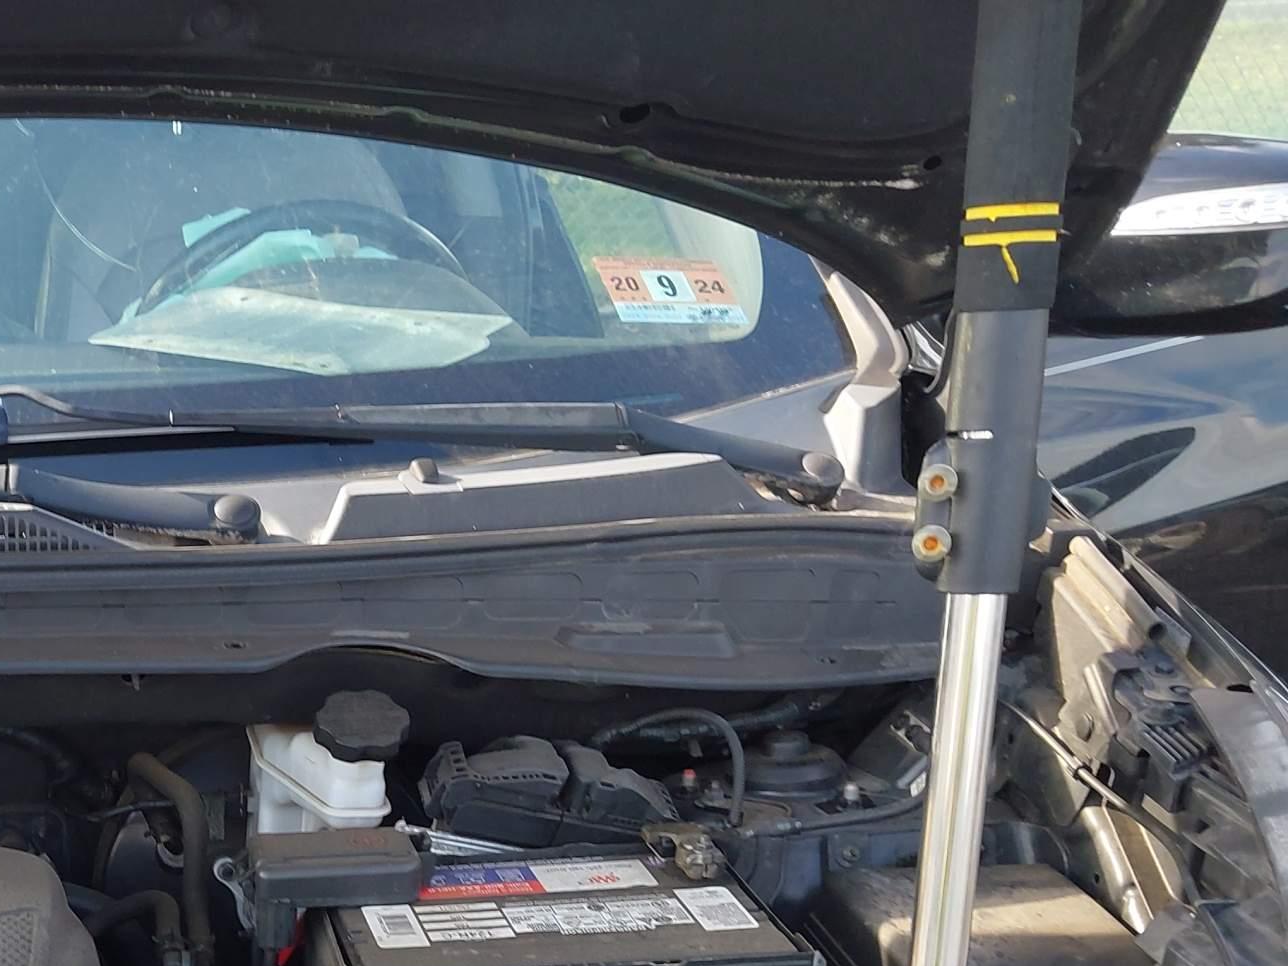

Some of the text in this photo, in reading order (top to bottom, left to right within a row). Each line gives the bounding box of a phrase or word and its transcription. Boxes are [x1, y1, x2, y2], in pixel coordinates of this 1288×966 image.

[610, 274, 726, 297] 20 9 24
